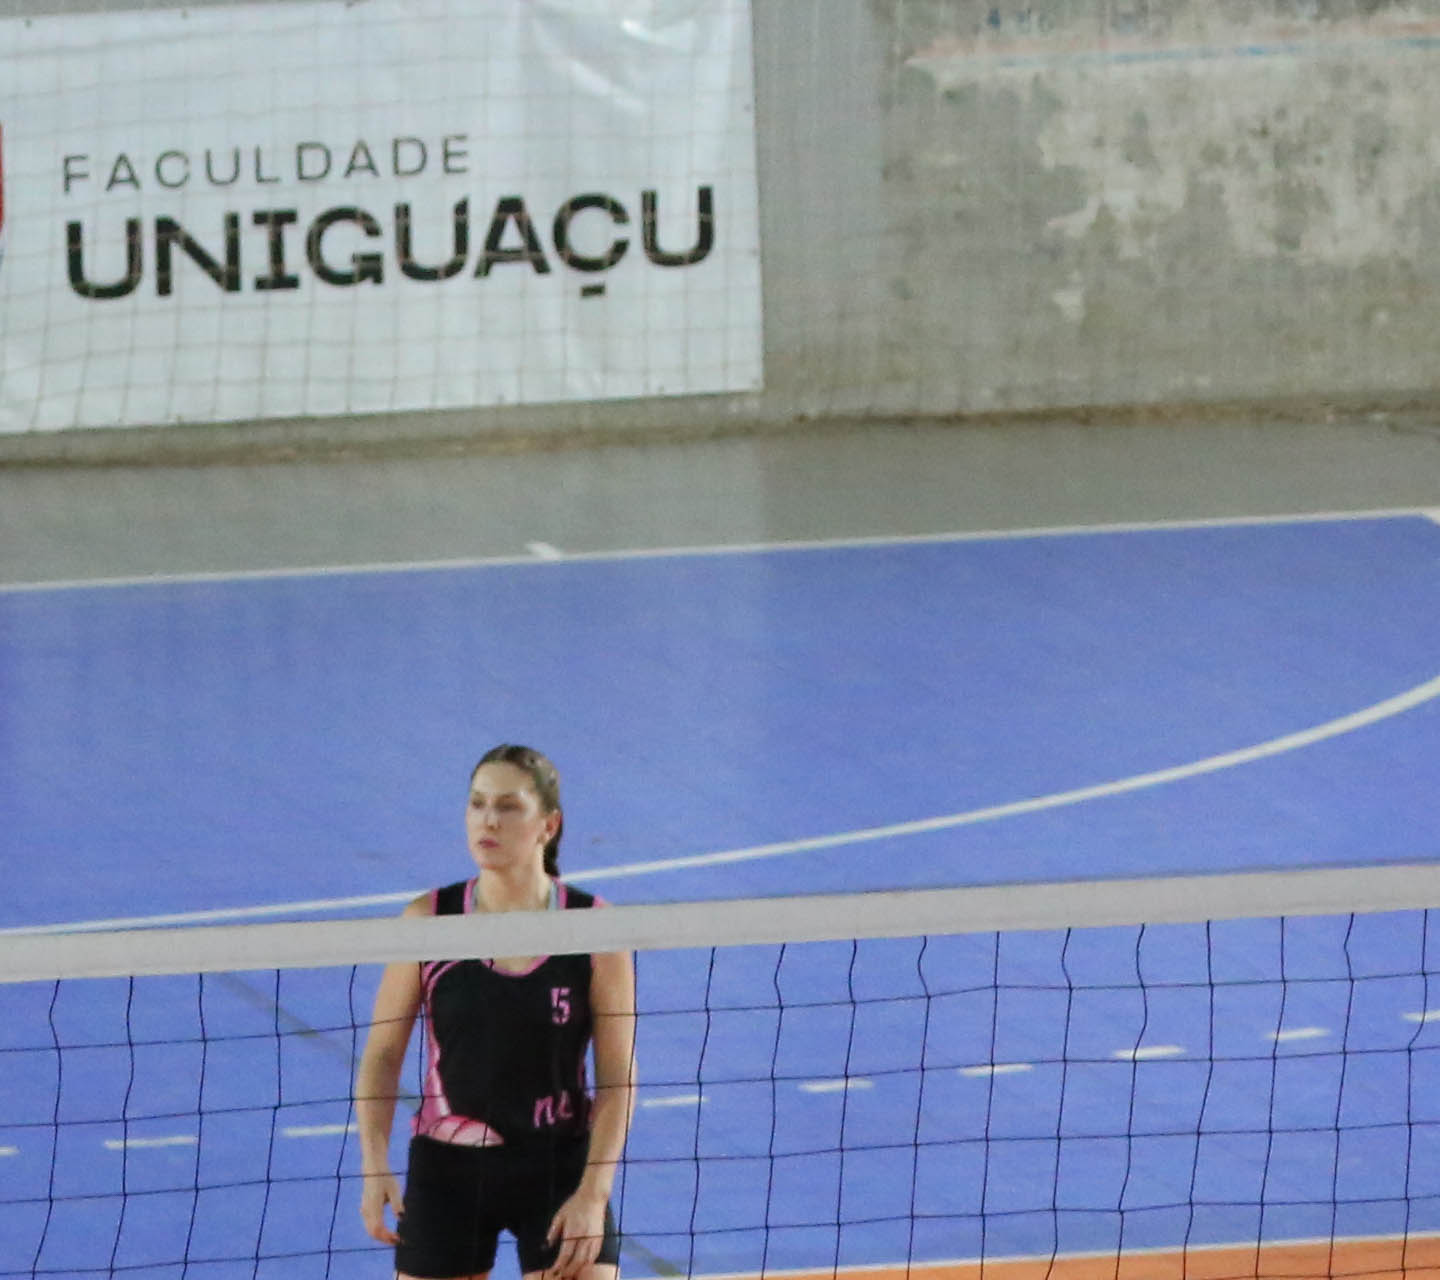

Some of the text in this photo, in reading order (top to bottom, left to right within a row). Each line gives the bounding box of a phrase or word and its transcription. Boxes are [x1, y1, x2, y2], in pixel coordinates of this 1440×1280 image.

[63, 135, 471, 195] FACULDADE
[66, 186, 714, 300] UNIGUAÇU
[551, 988, 571, 1024] 5
